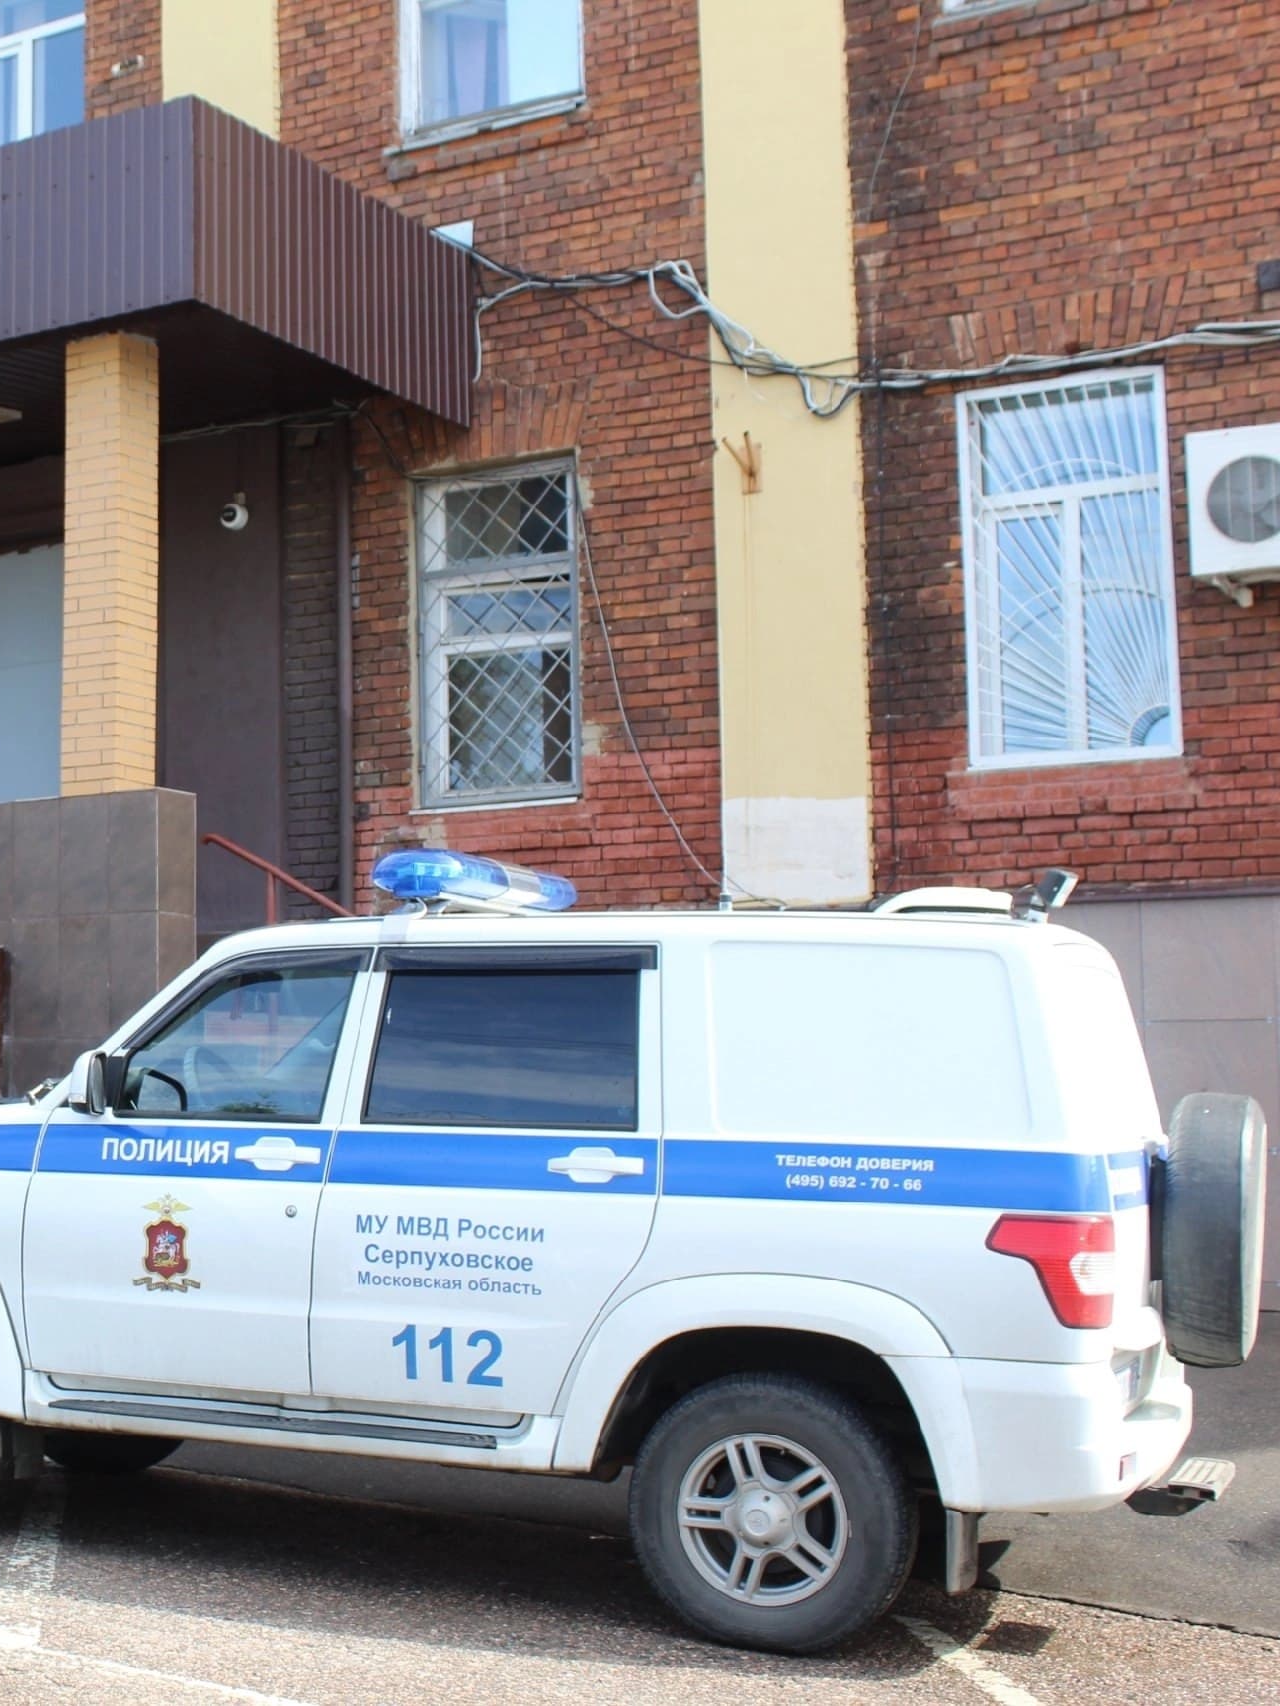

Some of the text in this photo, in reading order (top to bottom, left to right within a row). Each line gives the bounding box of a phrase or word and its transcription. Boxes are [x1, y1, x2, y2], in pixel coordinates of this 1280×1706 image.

[102, 1137, 230, 1166] ПОЛИЦИЯ
[775, 1154, 935, 1172] ТЕЛЕФОН ДОВЕРИЯ
[785, 1174, 825, 1190] (495)
[355, 1214, 545, 1242] МУ МВД России
[364, 1243, 534, 1272] Серпуховское
[357, 1271, 542, 1296] Московская область
[392, 1324, 504, 1387] 112
